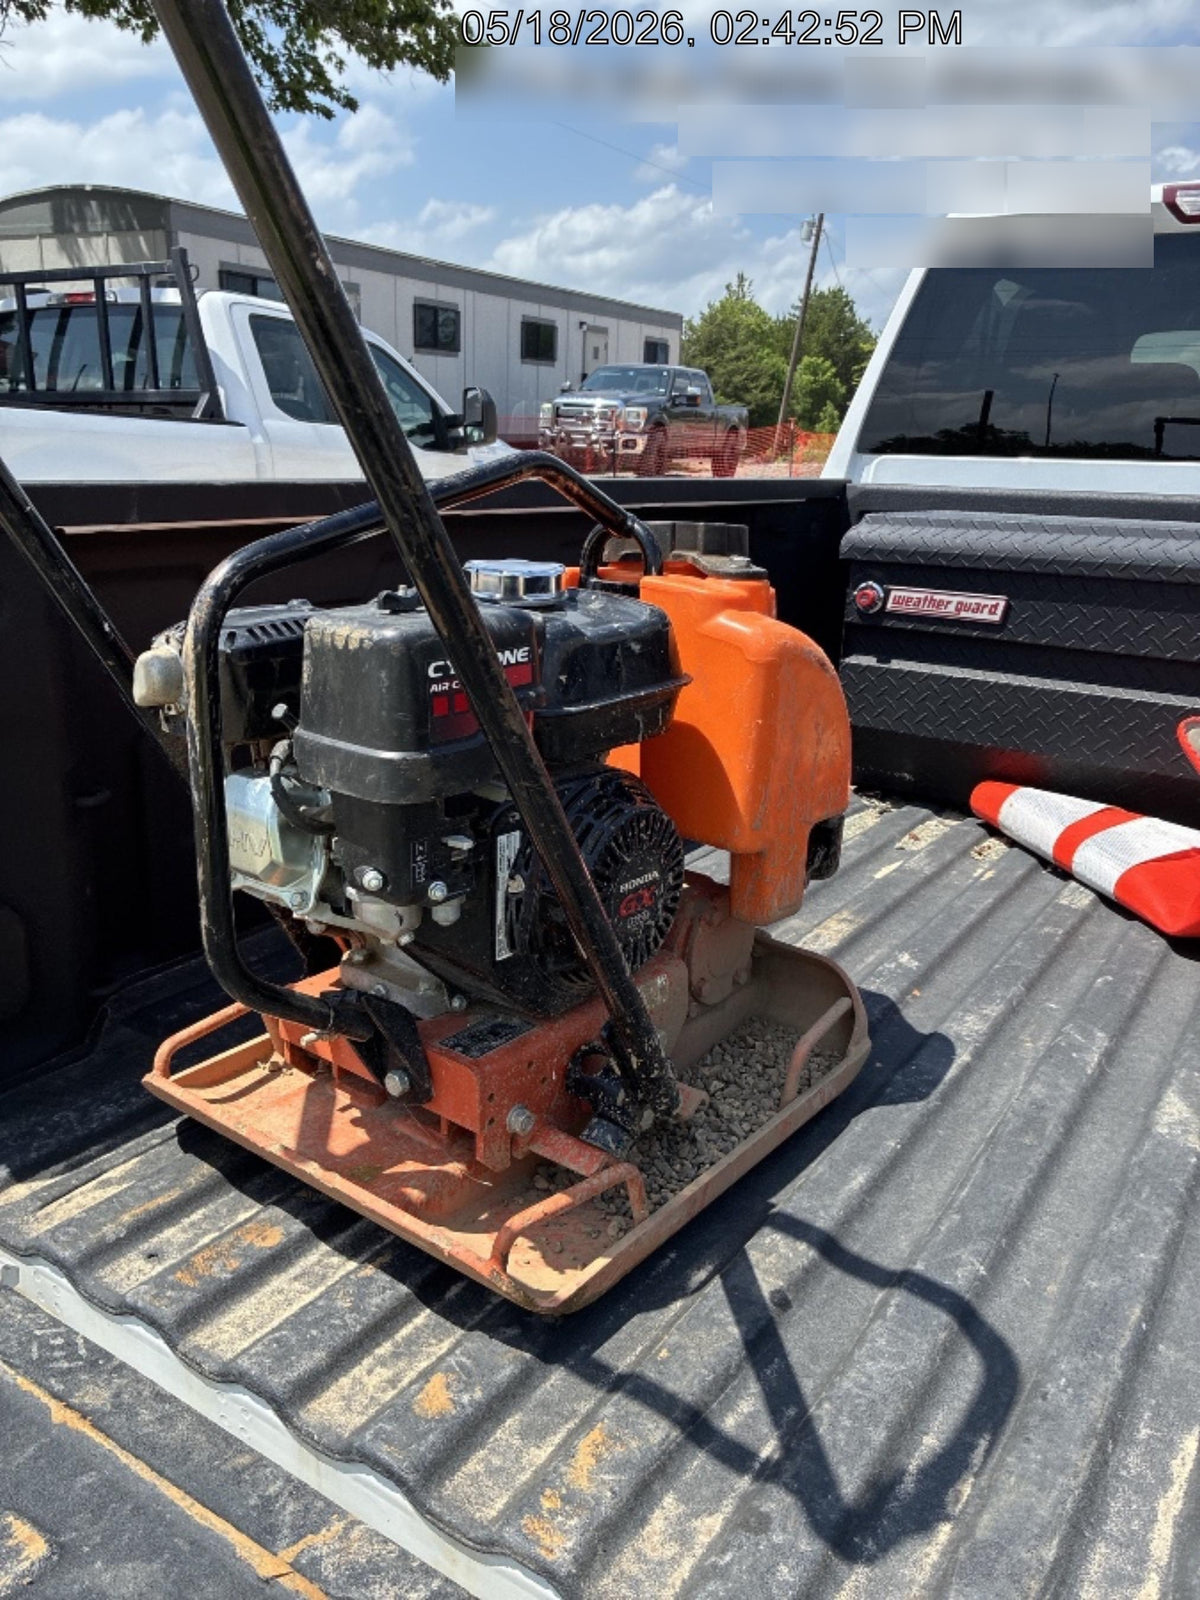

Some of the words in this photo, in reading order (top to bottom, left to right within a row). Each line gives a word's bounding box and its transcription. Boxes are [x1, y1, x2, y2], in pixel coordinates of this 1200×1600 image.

[892, 593, 951, 610] weather
[954, 600, 1000, 616] guard
[430, 681, 449, 694] AIR
[620, 870, 659, 894] HONDA
